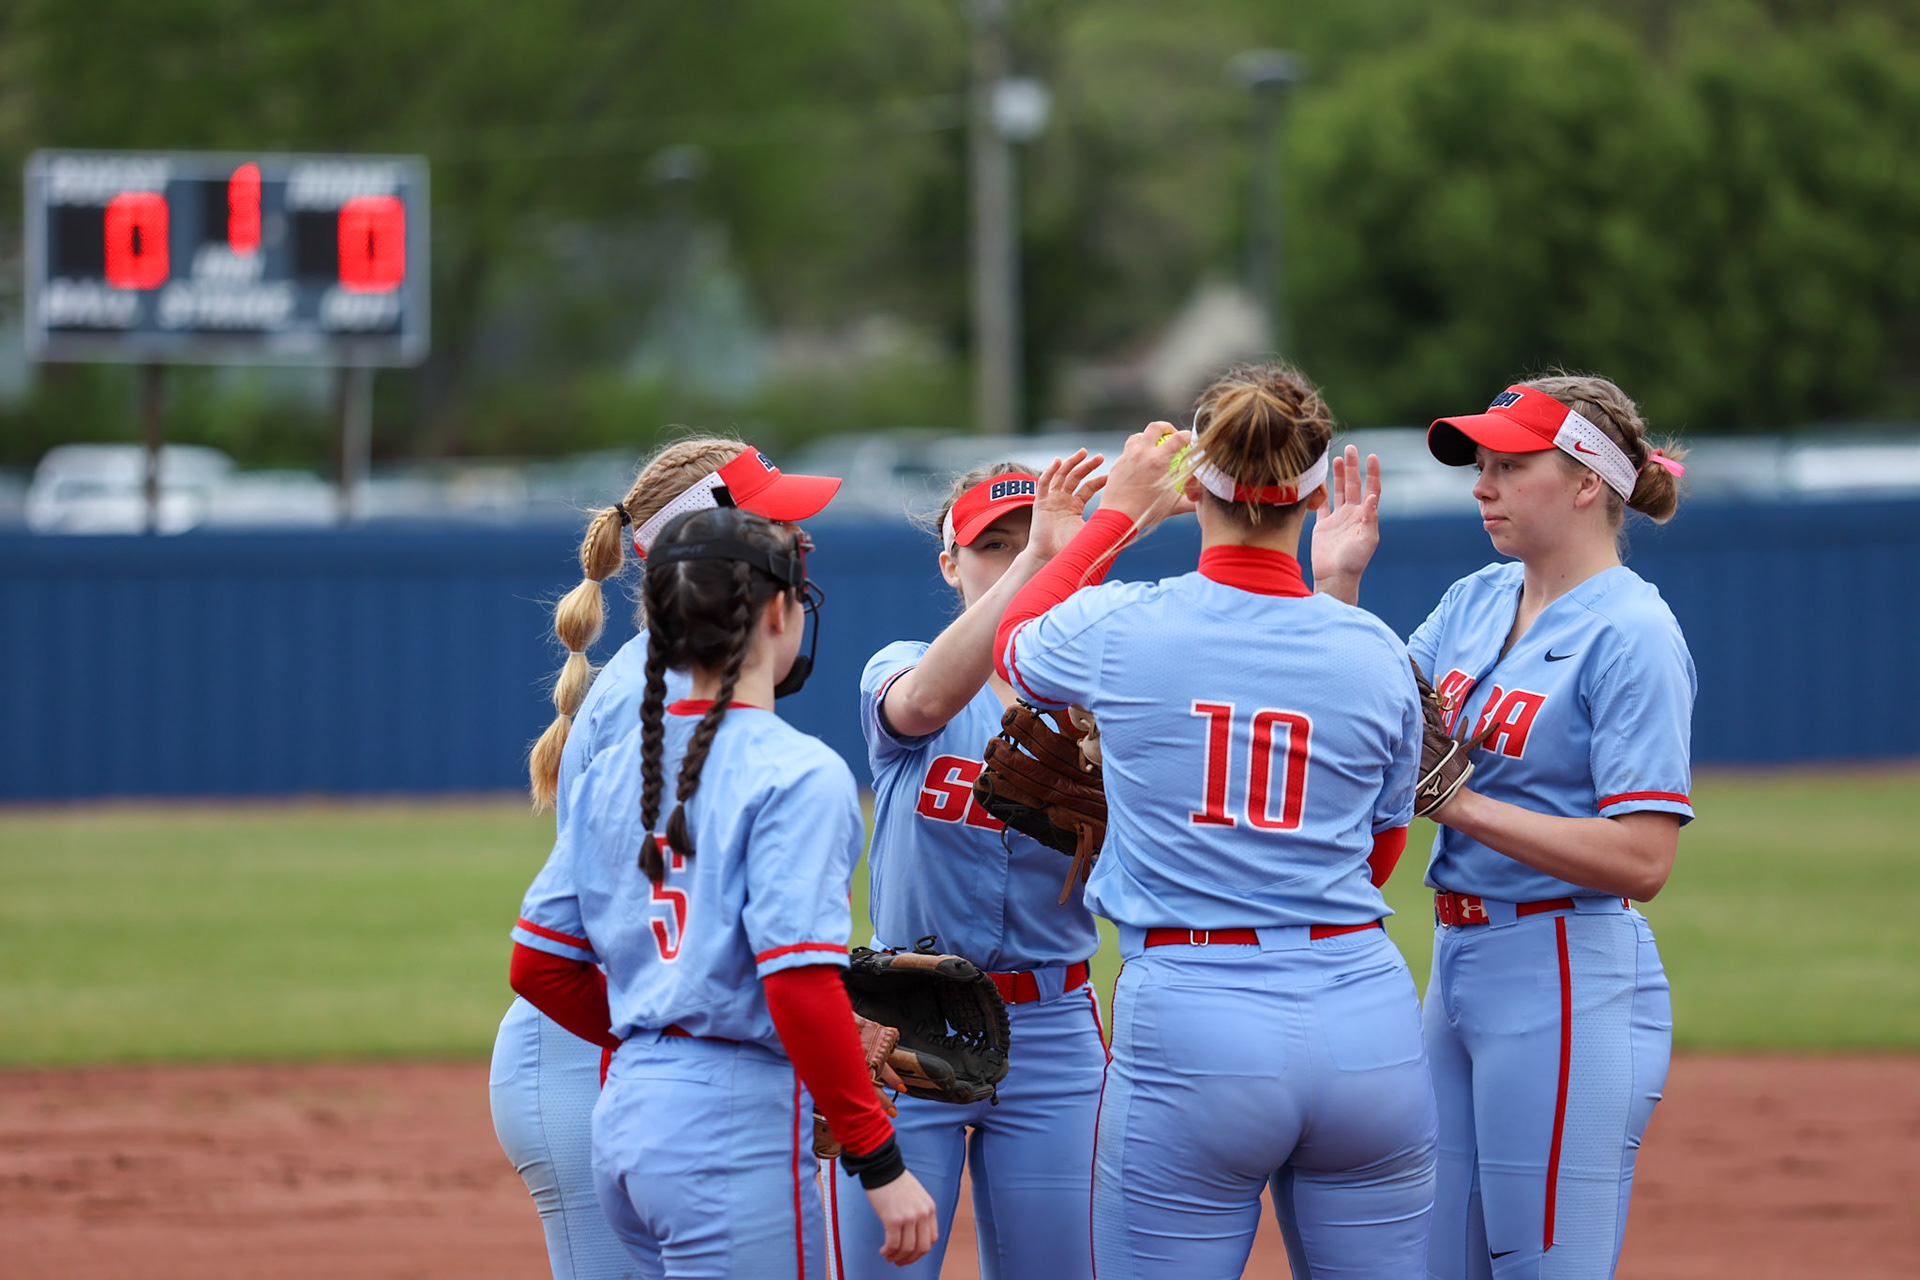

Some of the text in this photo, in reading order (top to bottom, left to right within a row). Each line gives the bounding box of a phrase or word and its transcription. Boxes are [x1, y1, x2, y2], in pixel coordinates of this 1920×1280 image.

[990, 480, 1036, 501] SBA
[1189, 699, 1314, 833] 10
[649, 832, 690, 964] 5
